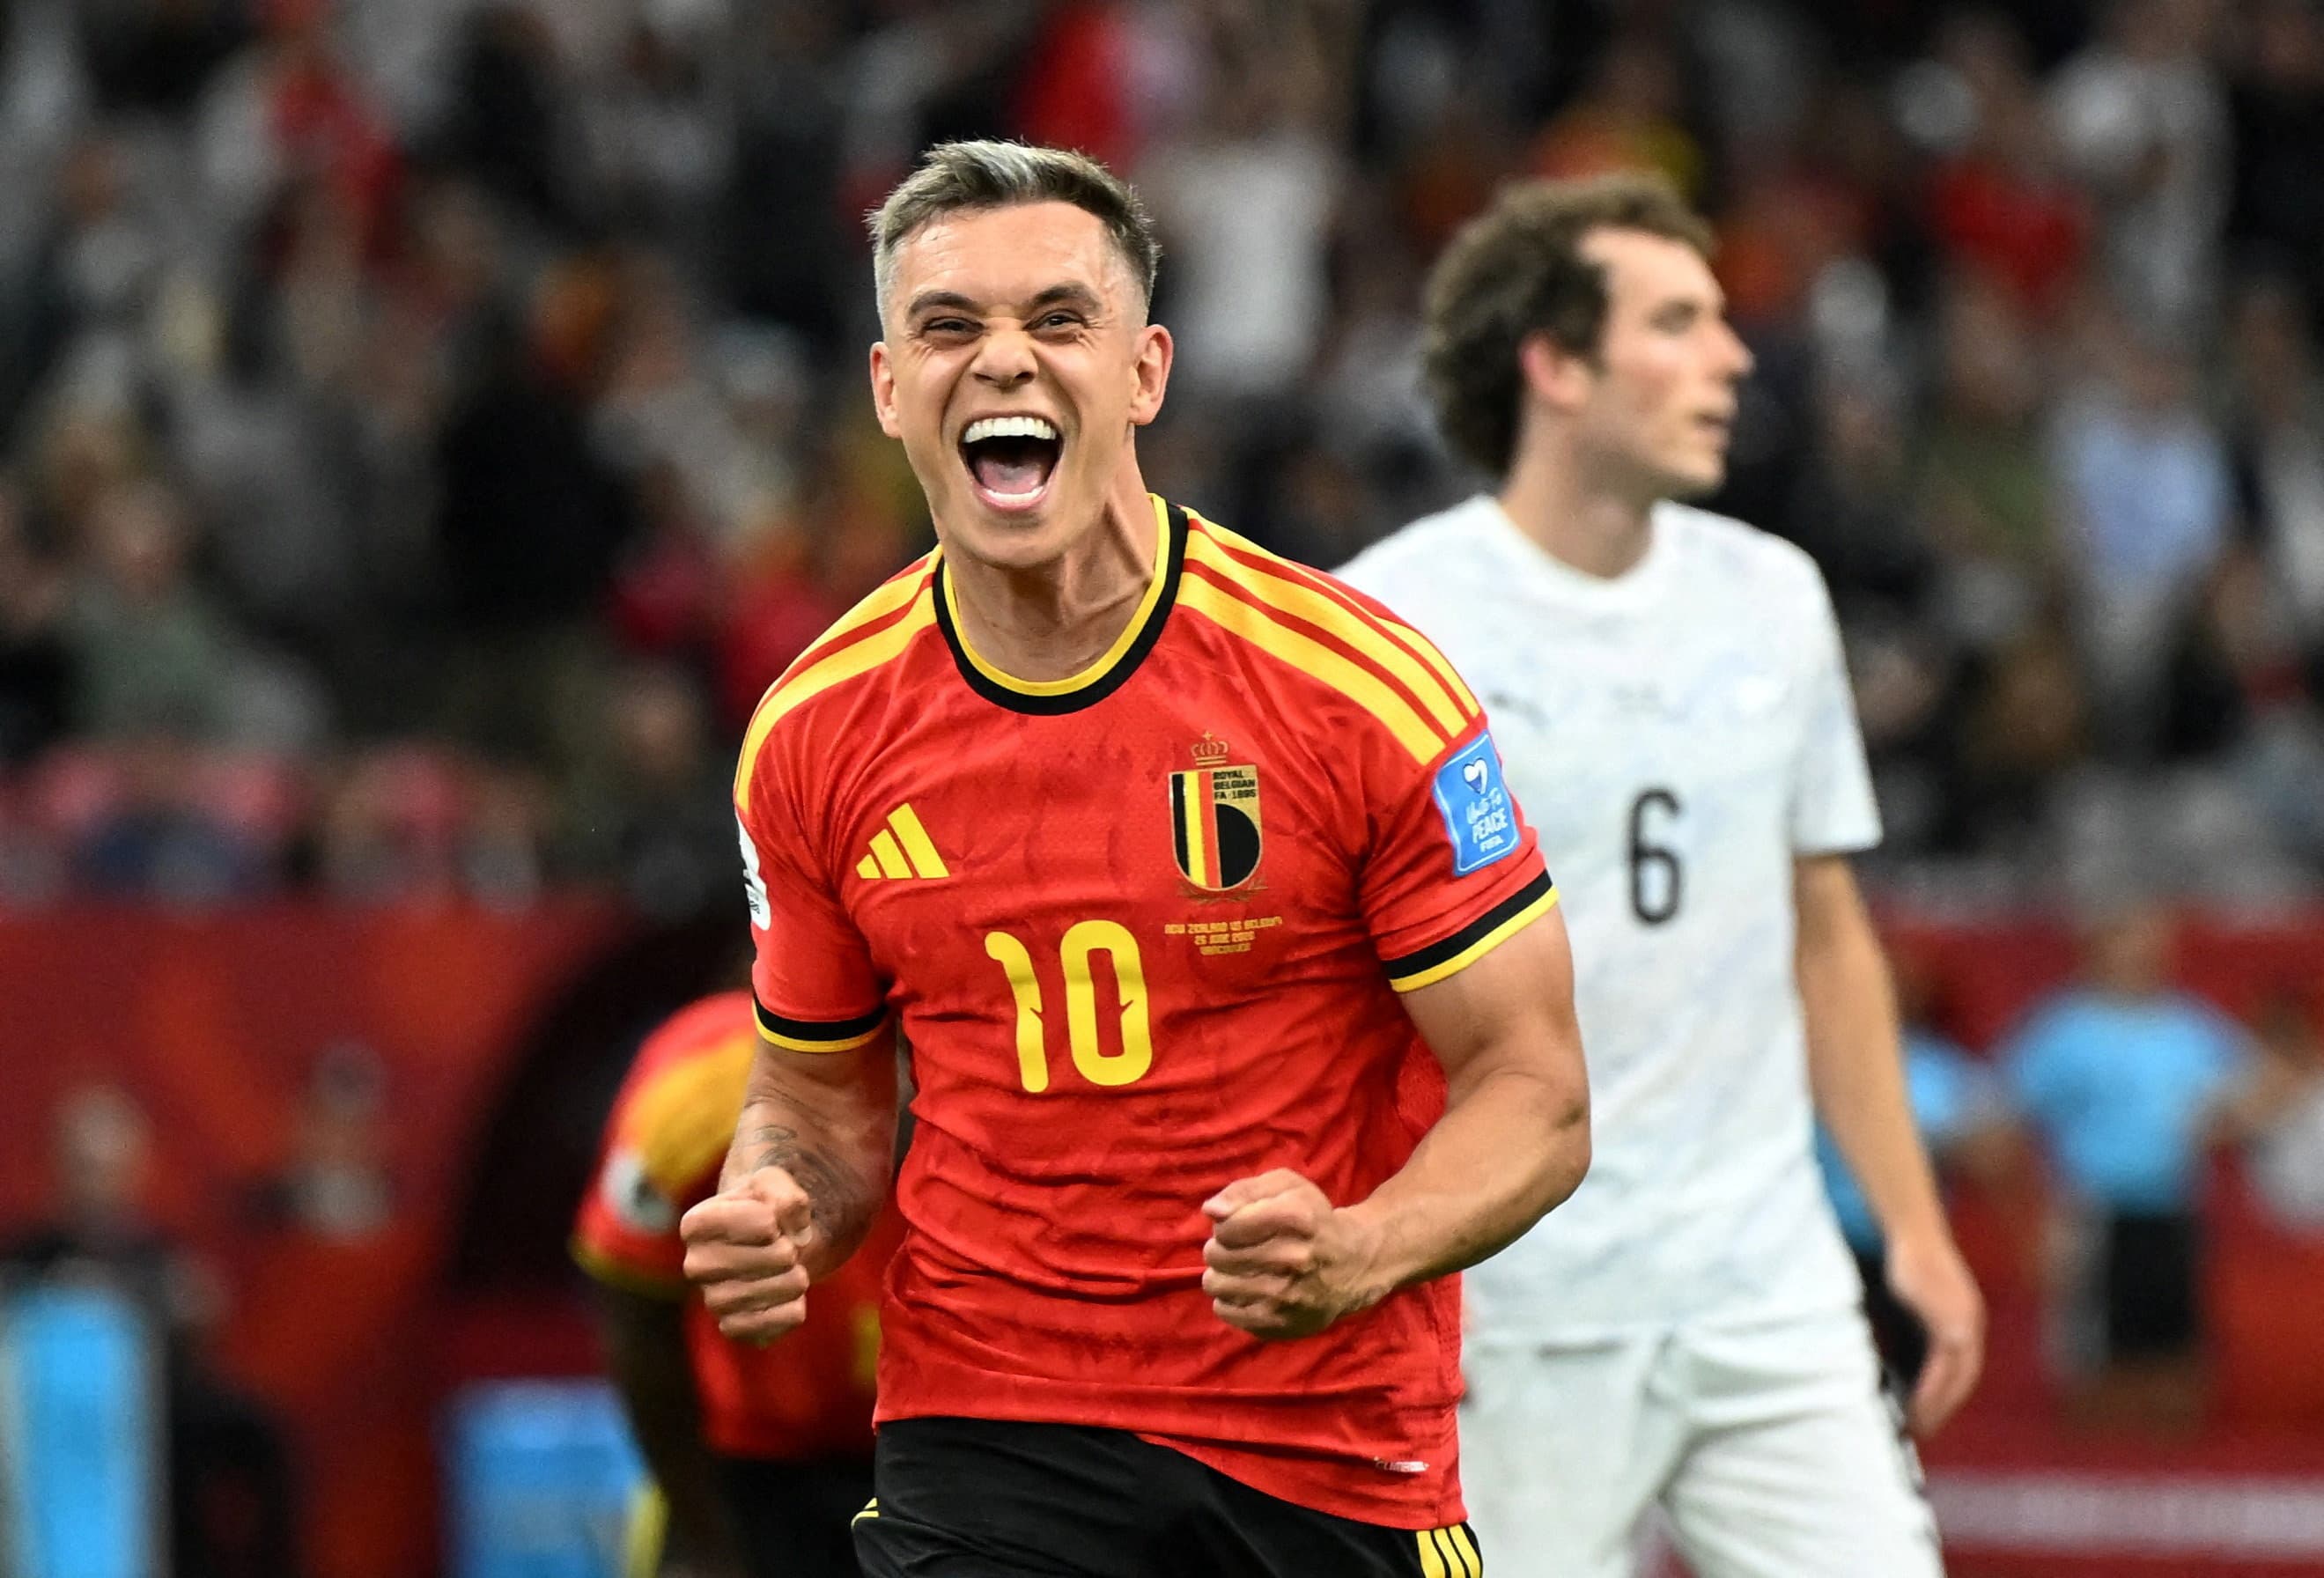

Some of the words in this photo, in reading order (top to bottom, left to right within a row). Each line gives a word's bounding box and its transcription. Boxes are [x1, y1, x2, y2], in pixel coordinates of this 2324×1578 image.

[1214, 791, 1227, 800] FA
[1472, 807, 1509, 844] PEACE
[1628, 785, 1683, 926] 6
[985, 919, 1153, 1093] 10
